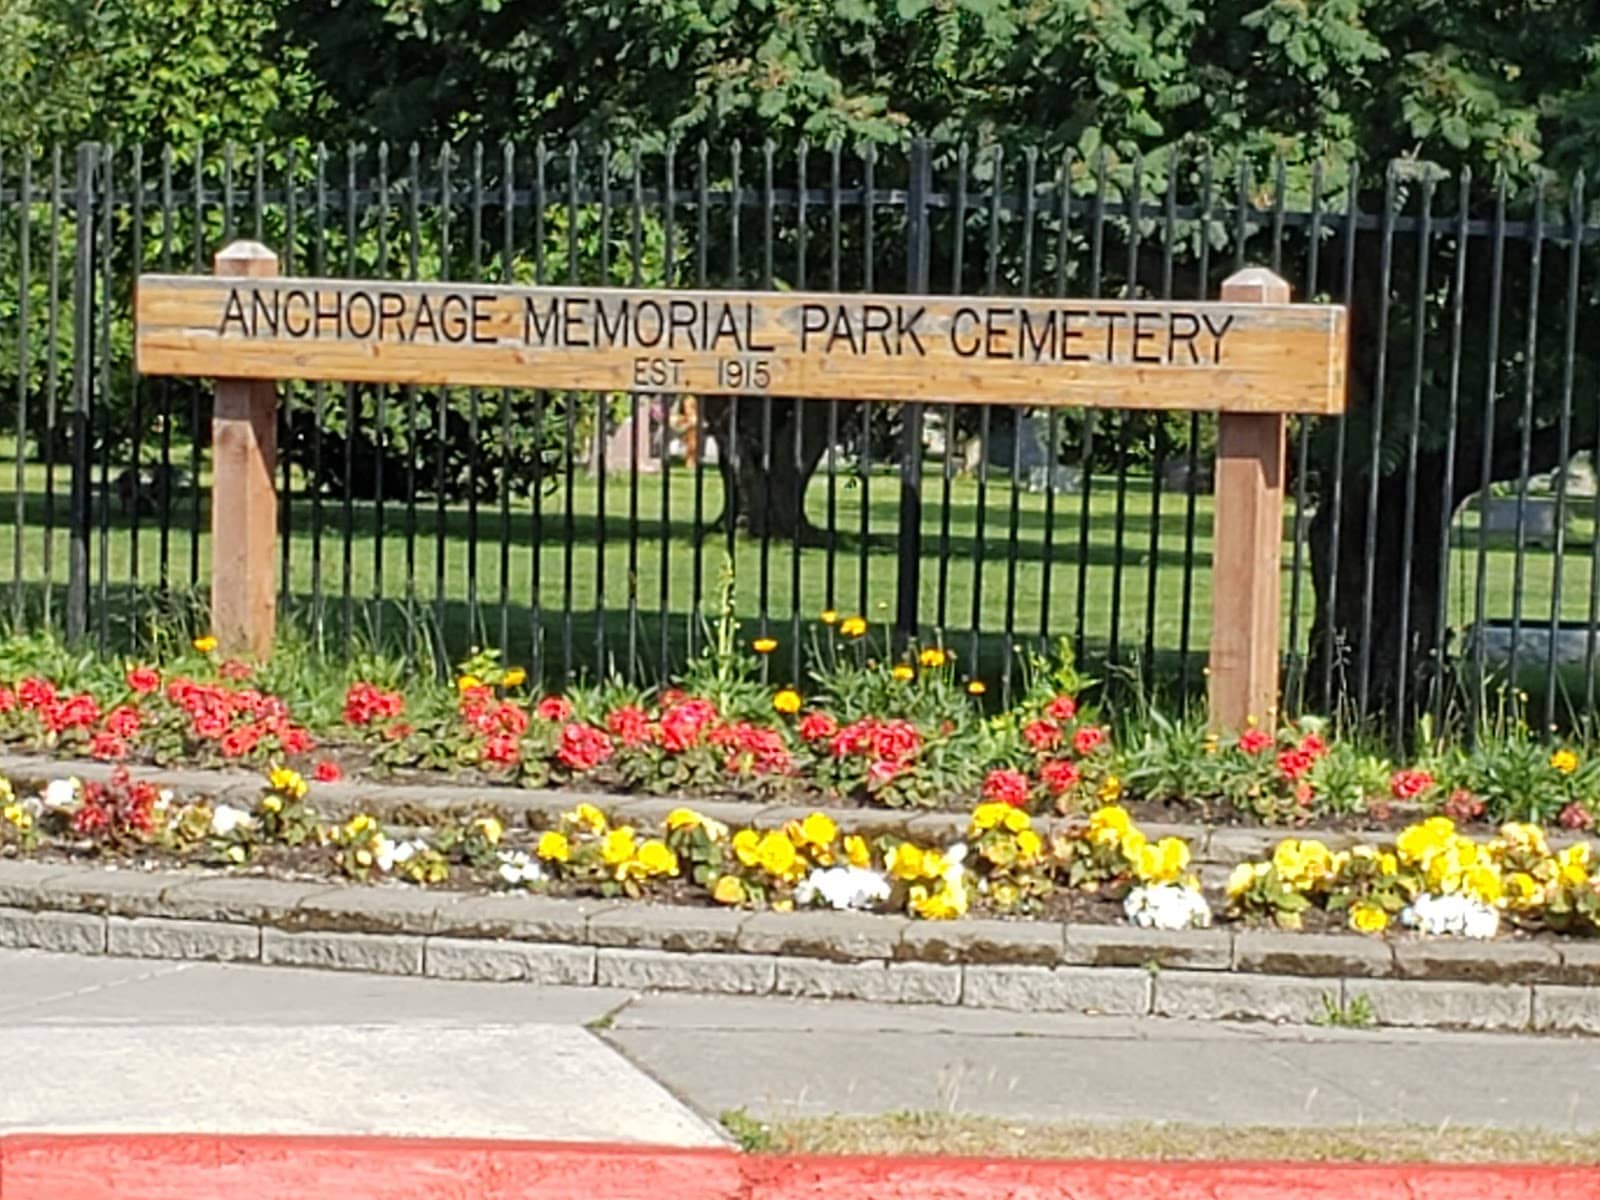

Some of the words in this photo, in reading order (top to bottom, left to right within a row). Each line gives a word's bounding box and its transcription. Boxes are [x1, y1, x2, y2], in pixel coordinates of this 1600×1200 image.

[219, 288, 498, 343] ANCHORAGE
[524, 297, 775, 351] MEMORIAL
[801, 304, 926, 356] PARK
[950, 308, 1234, 364] CEMETERY
[634, 357, 691, 387] EST.
[718, 360, 771, 388] 1915
